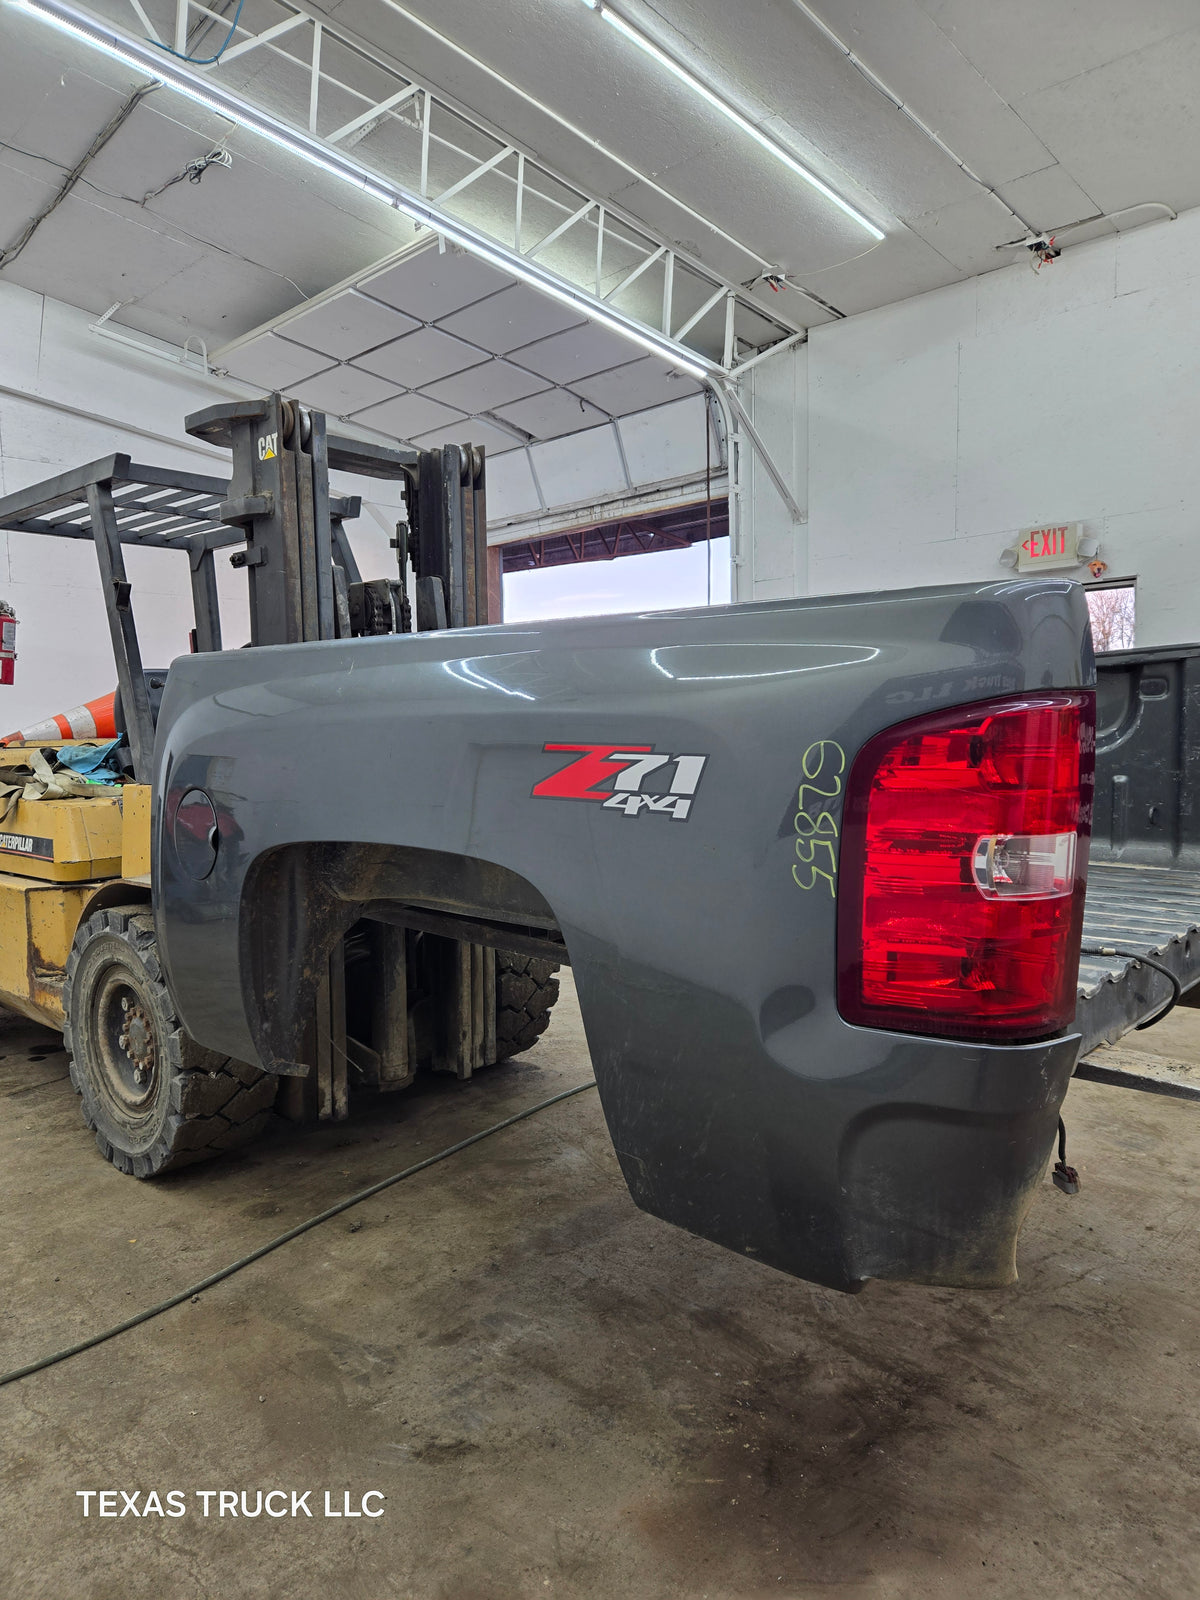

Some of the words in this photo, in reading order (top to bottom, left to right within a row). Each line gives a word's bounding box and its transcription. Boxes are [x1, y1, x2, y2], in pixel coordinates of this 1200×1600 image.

[258, 431, 278, 461] CAT
[1029, 526, 1069, 558] EXIT
[531, 742, 708, 801] Z71
